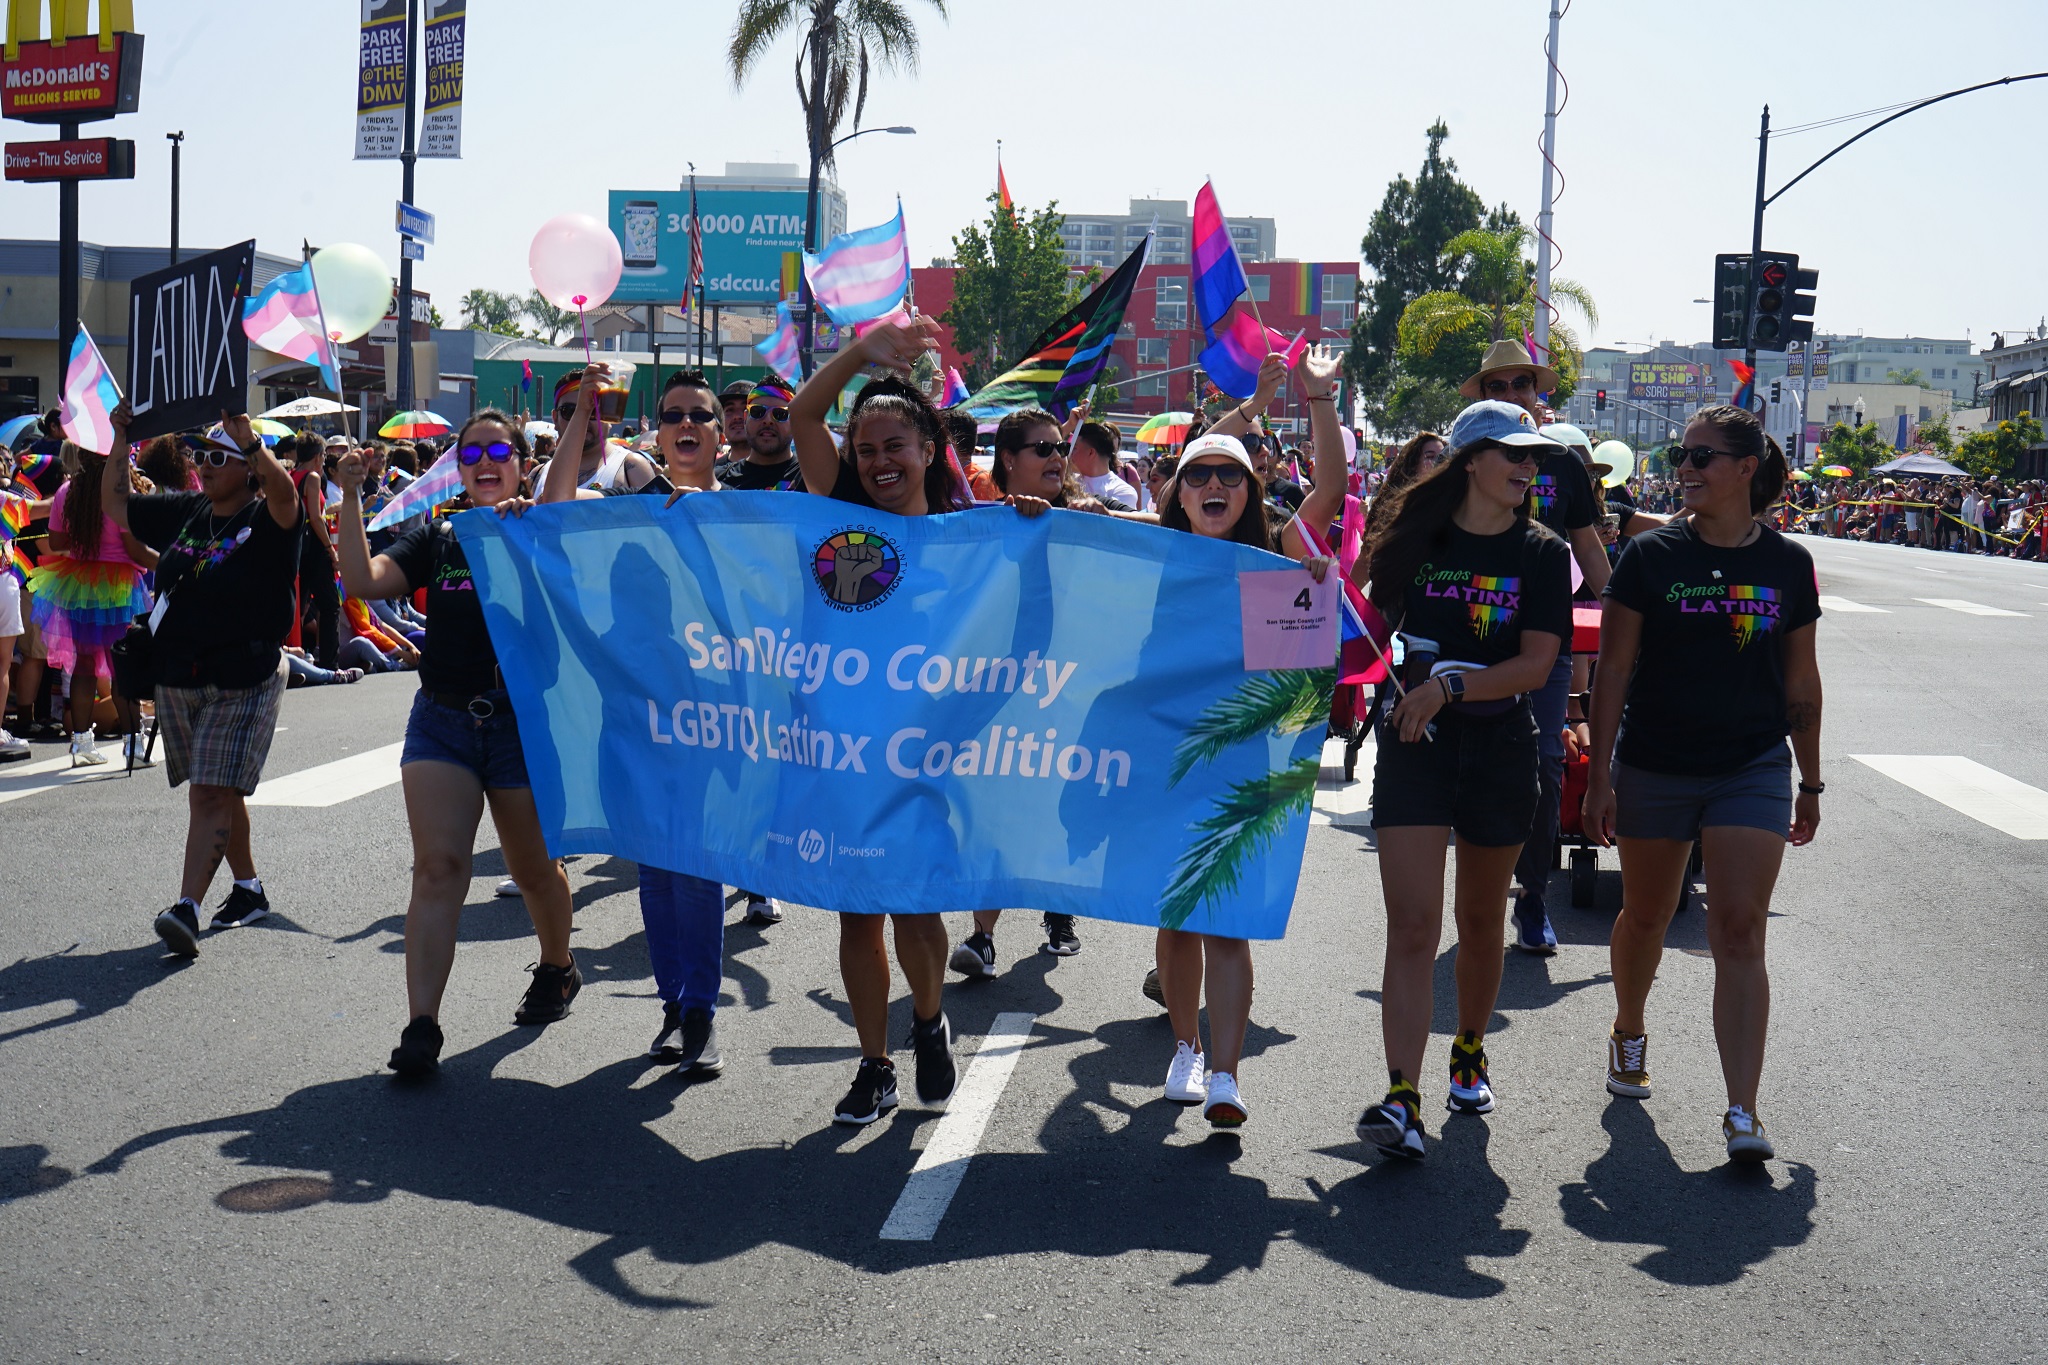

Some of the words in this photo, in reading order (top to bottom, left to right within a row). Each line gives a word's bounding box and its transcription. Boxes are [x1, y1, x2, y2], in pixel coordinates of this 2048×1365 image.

[360, 28, 402, 49] PARK
[426, 24, 461, 47] PARK
[361, 45, 403, 68] FREE
[428, 42, 462, 66] FREE
[5, 62, 110, 88] McDonald's
[362, 65, 404, 84] @THE
[430, 62, 463, 83] @THE
[14, 90, 60, 106] BILLIONS
[63, 88, 101, 101] SERVED
[363, 82, 404, 104] DMV
[430, 81, 463, 102] DMV
[432, 115, 453, 123] FRIDAYS
[64, 150, 102, 165] Service
[667, 213, 745, 234] 30000
[746, 238, 762, 246] Find
[797, 240, 805, 248] yo
[710, 273, 780, 292] sdccu.c
[132, 257, 246, 416] LATINX
[1814, 340, 1823, 352] P
[1632, 371, 1656, 384] CBD
[1652, 364, 1687, 372] ONE-STOP
[1686, 376, 1693, 385] P
[1705, 376, 1713, 385] P
[1645, 386, 1668, 398] SDRC
[810, 536, 827, 559] SAN
[830, 524, 876, 535] DIEGO
[880, 532, 908, 575] COUNTY
[1414, 563, 1471, 586] Somos
[824, 595, 853, 613] LATINO
[855, 575, 905, 613] COALITION
[1294, 588, 1312, 611] 4
[1425, 583, 1521, 609] LATINX
[1666, 582, 1726, 602] Somos
[1680, 599, 1781, 618] LATINX
[886, 644, 1078, 709] County
[647, 699, 759, 763] LGBTQ
[763, 710, 873, 774] Latinx
[885, 725, 1132, 787] Coalition
[785, 835, 794, 845] BY
[838, 845, 885, 857] SPONSOR
